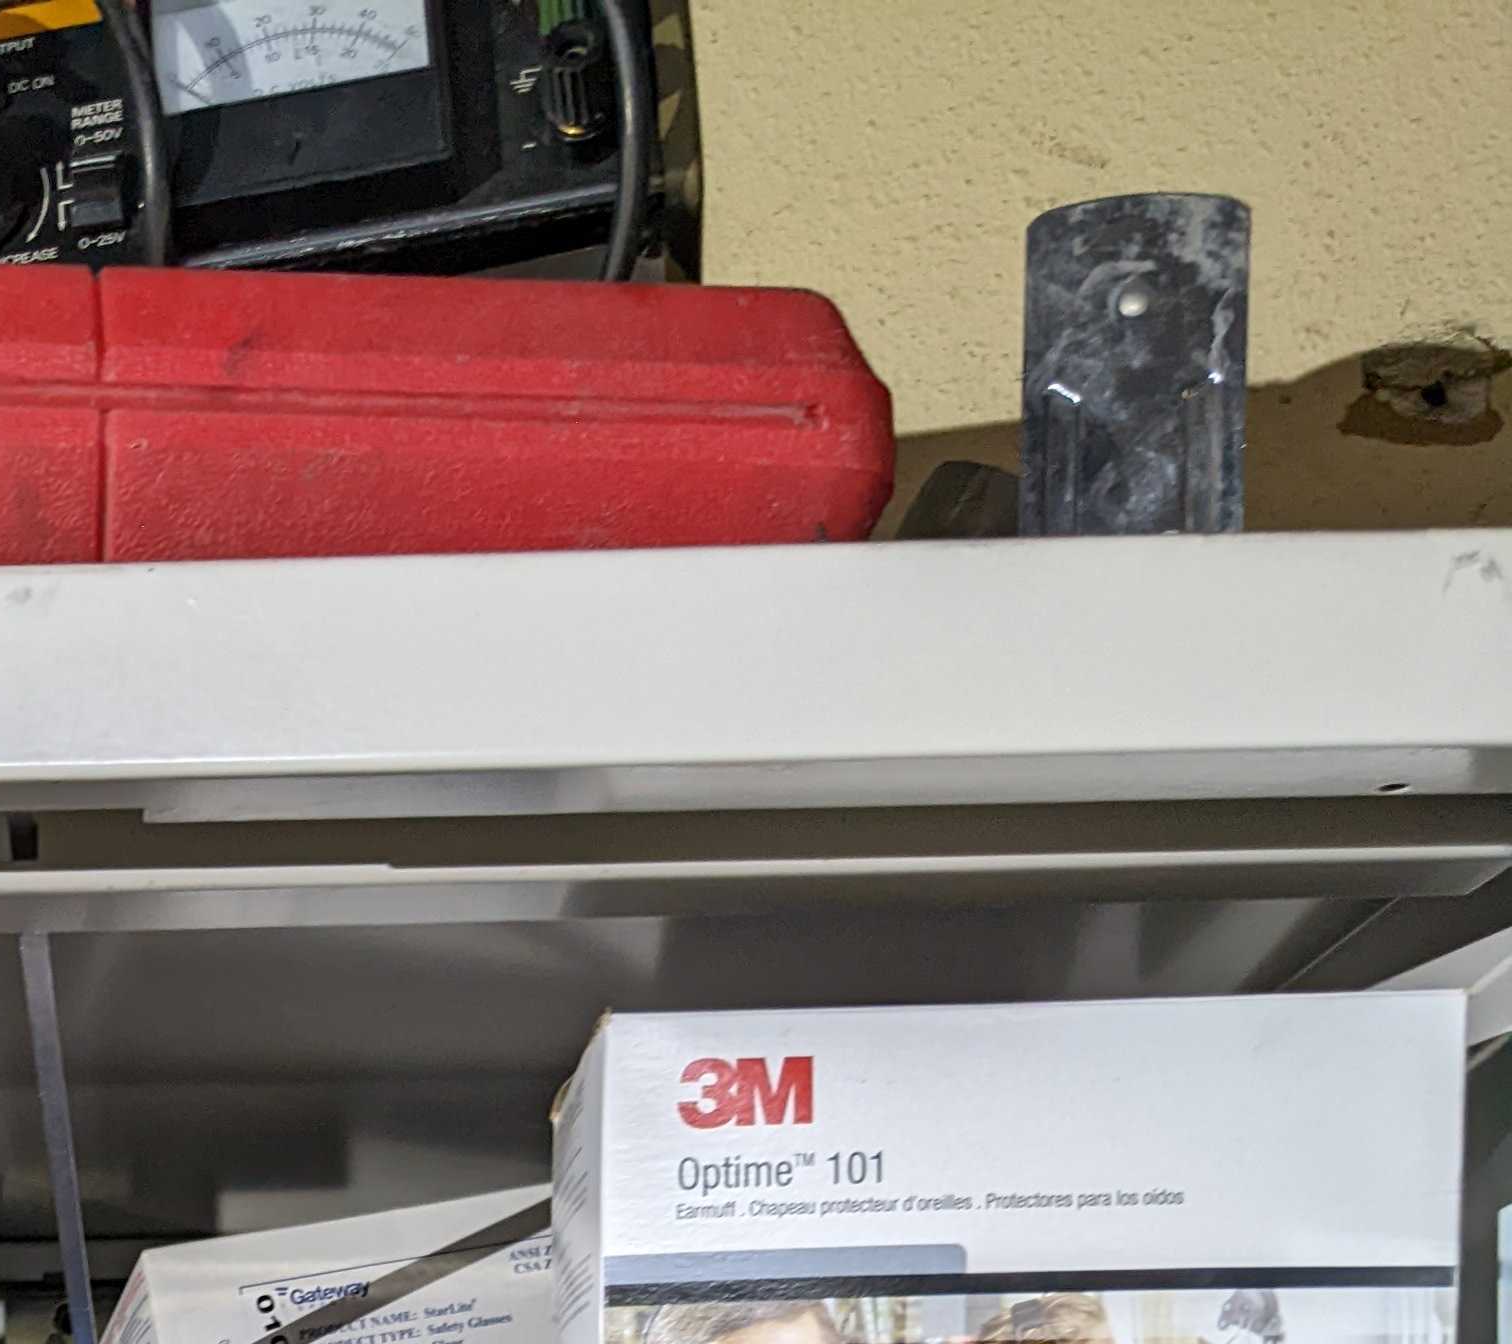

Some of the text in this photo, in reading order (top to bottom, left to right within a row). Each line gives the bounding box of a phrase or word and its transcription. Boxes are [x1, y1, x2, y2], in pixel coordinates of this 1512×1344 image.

[7, 74, 55, 95] DC ON
[70, 98, 124, 119] METER
[70, 110, 124, 131] RANGE
[73, 126, 124, 147] 0-50V
[77, 230, 127, 250] 0-25V
[676, 1055, 815, 1129] 3M
[824, 1149, 886, 1186] 101
[674, 1202, 737, 1220] Earmuff
[748, 1199, 816, 1219] Chapeau
[820, 1197, 899, 1217] protecteur
[984, 1190, 1073, 1210] Protectores
[1075, 1191, 1113, 1211] para
[1115, 1188, 1139, 1205] los
[289, 1280, 371, 1305] Gateway
[369, 1309, 419, 1327] NAME:
[378, 1326, 422, 1344] TYPE:
[426, 1320, 465, 1336] Safety
[467, 1314, 513, 1329] Glasses
